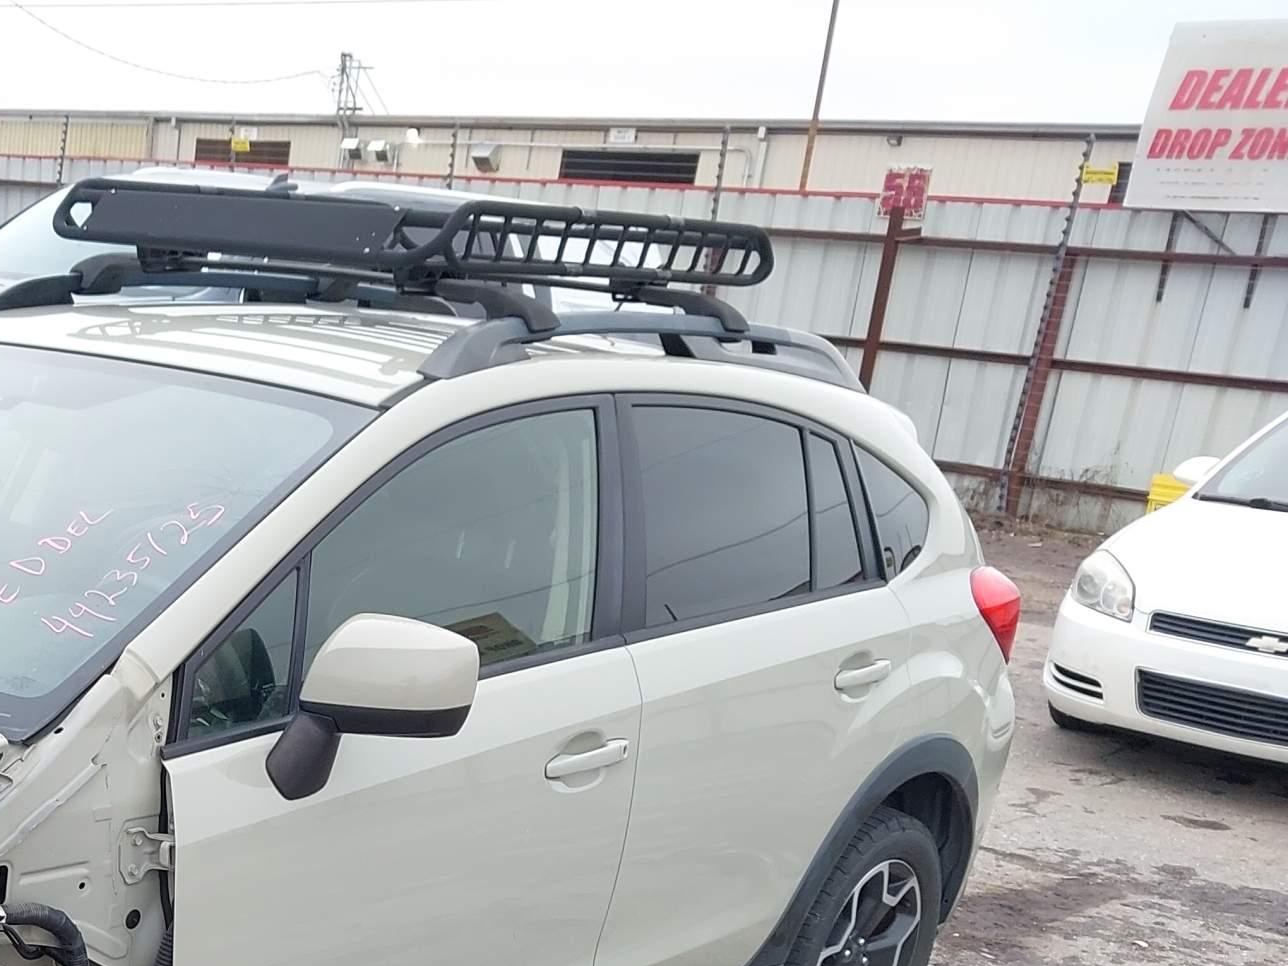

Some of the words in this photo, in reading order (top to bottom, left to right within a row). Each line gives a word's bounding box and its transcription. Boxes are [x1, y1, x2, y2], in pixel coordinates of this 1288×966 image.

[1168, 67, 1288, 111] DEALE
[1146, 128, 1233, 160] DROP
[1228, 127, 1288, 160] ZON
[40, 502, 225, 638] 44235125
